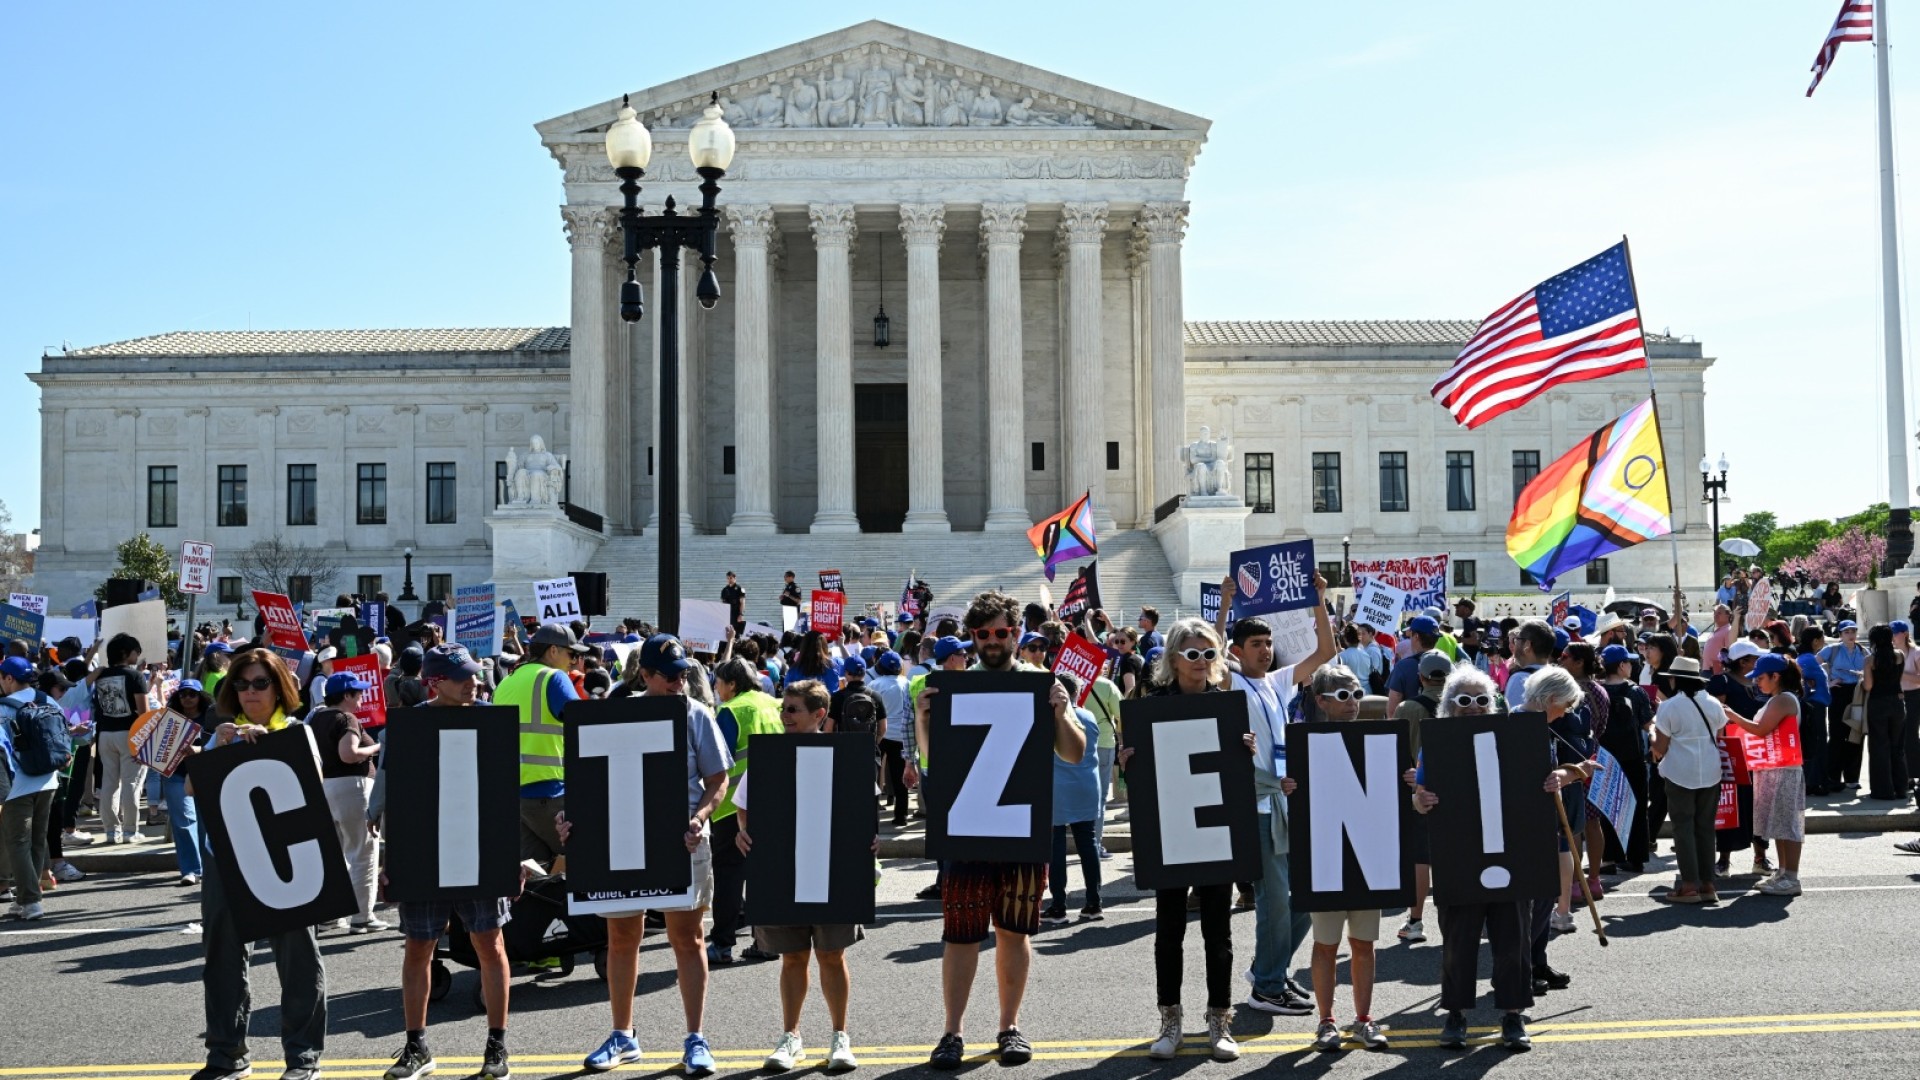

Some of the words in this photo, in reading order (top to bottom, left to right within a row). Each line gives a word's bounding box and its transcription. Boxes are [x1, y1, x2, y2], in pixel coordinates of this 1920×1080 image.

[759, 162, 817, 177] EQUAL
[824, 162, 888, 177] JUSTICE
[896, 162, 957, 177] UNDER
[960, 162, 993, 177] LAW
[192, 545, 203, 556] NO
[184, 555, 210, 567] PARKING
[1268, 551, 1294, 568] ALL
[1295, 552, 1306, 562] for
[188, 574, 203, 583] TIME
[189, 566, 203, 575] ANY
[1269, 562, 1302, 579] ONE
[457, 584, 494, 595] BIRTHRIGHT
[538, 584, 549, 592] My
[551, 581, 573, 589] Torch
[1276, 574, 1309, 590] ONE
[540, 592, 575, 600] Welcomes
[1203, 593, 1222, 607] BIR
[1270, 592, 1282, 604] for
[1280, 588, 1306, 603] ALL
[1371, 598, 1391, 610] HERE
[1373, 592, 1395, 605] BORN
[260, 605, 297, 624] 14TH
[457, 602, 494, 613] BIRTHRIGHT
[543, 601, 579, 619] ALL
[814, 600, 840, 613] BIRTH
[1362, 606, 1393, 622] BELONG
[814, 612, 840, 625] RIGHT
[1366, 614, 1387, 627] HERE
[1073, 643, 1095, 660] Protect
[1059, 647, 1098, 681] BIRTH
[130, 712, 162, 746] RESPECT
[155, 717, 174, 763] CITIZENSHIP
[160, 720, 181, 763] BIRTHRIGHT
[1744, 733, 1768, 768] 14T
[947, 692, 1035, 838] Z
[578, 719, 674, 871] T
[1151, 717, 1233, 865] E
[438, 729, 479, 888] I
[1307, 732, 1401, 892] N
[1473, 731, 1511, 889] !
[794, 746, 834, 903] I
[221, 759, 325, 909] C
